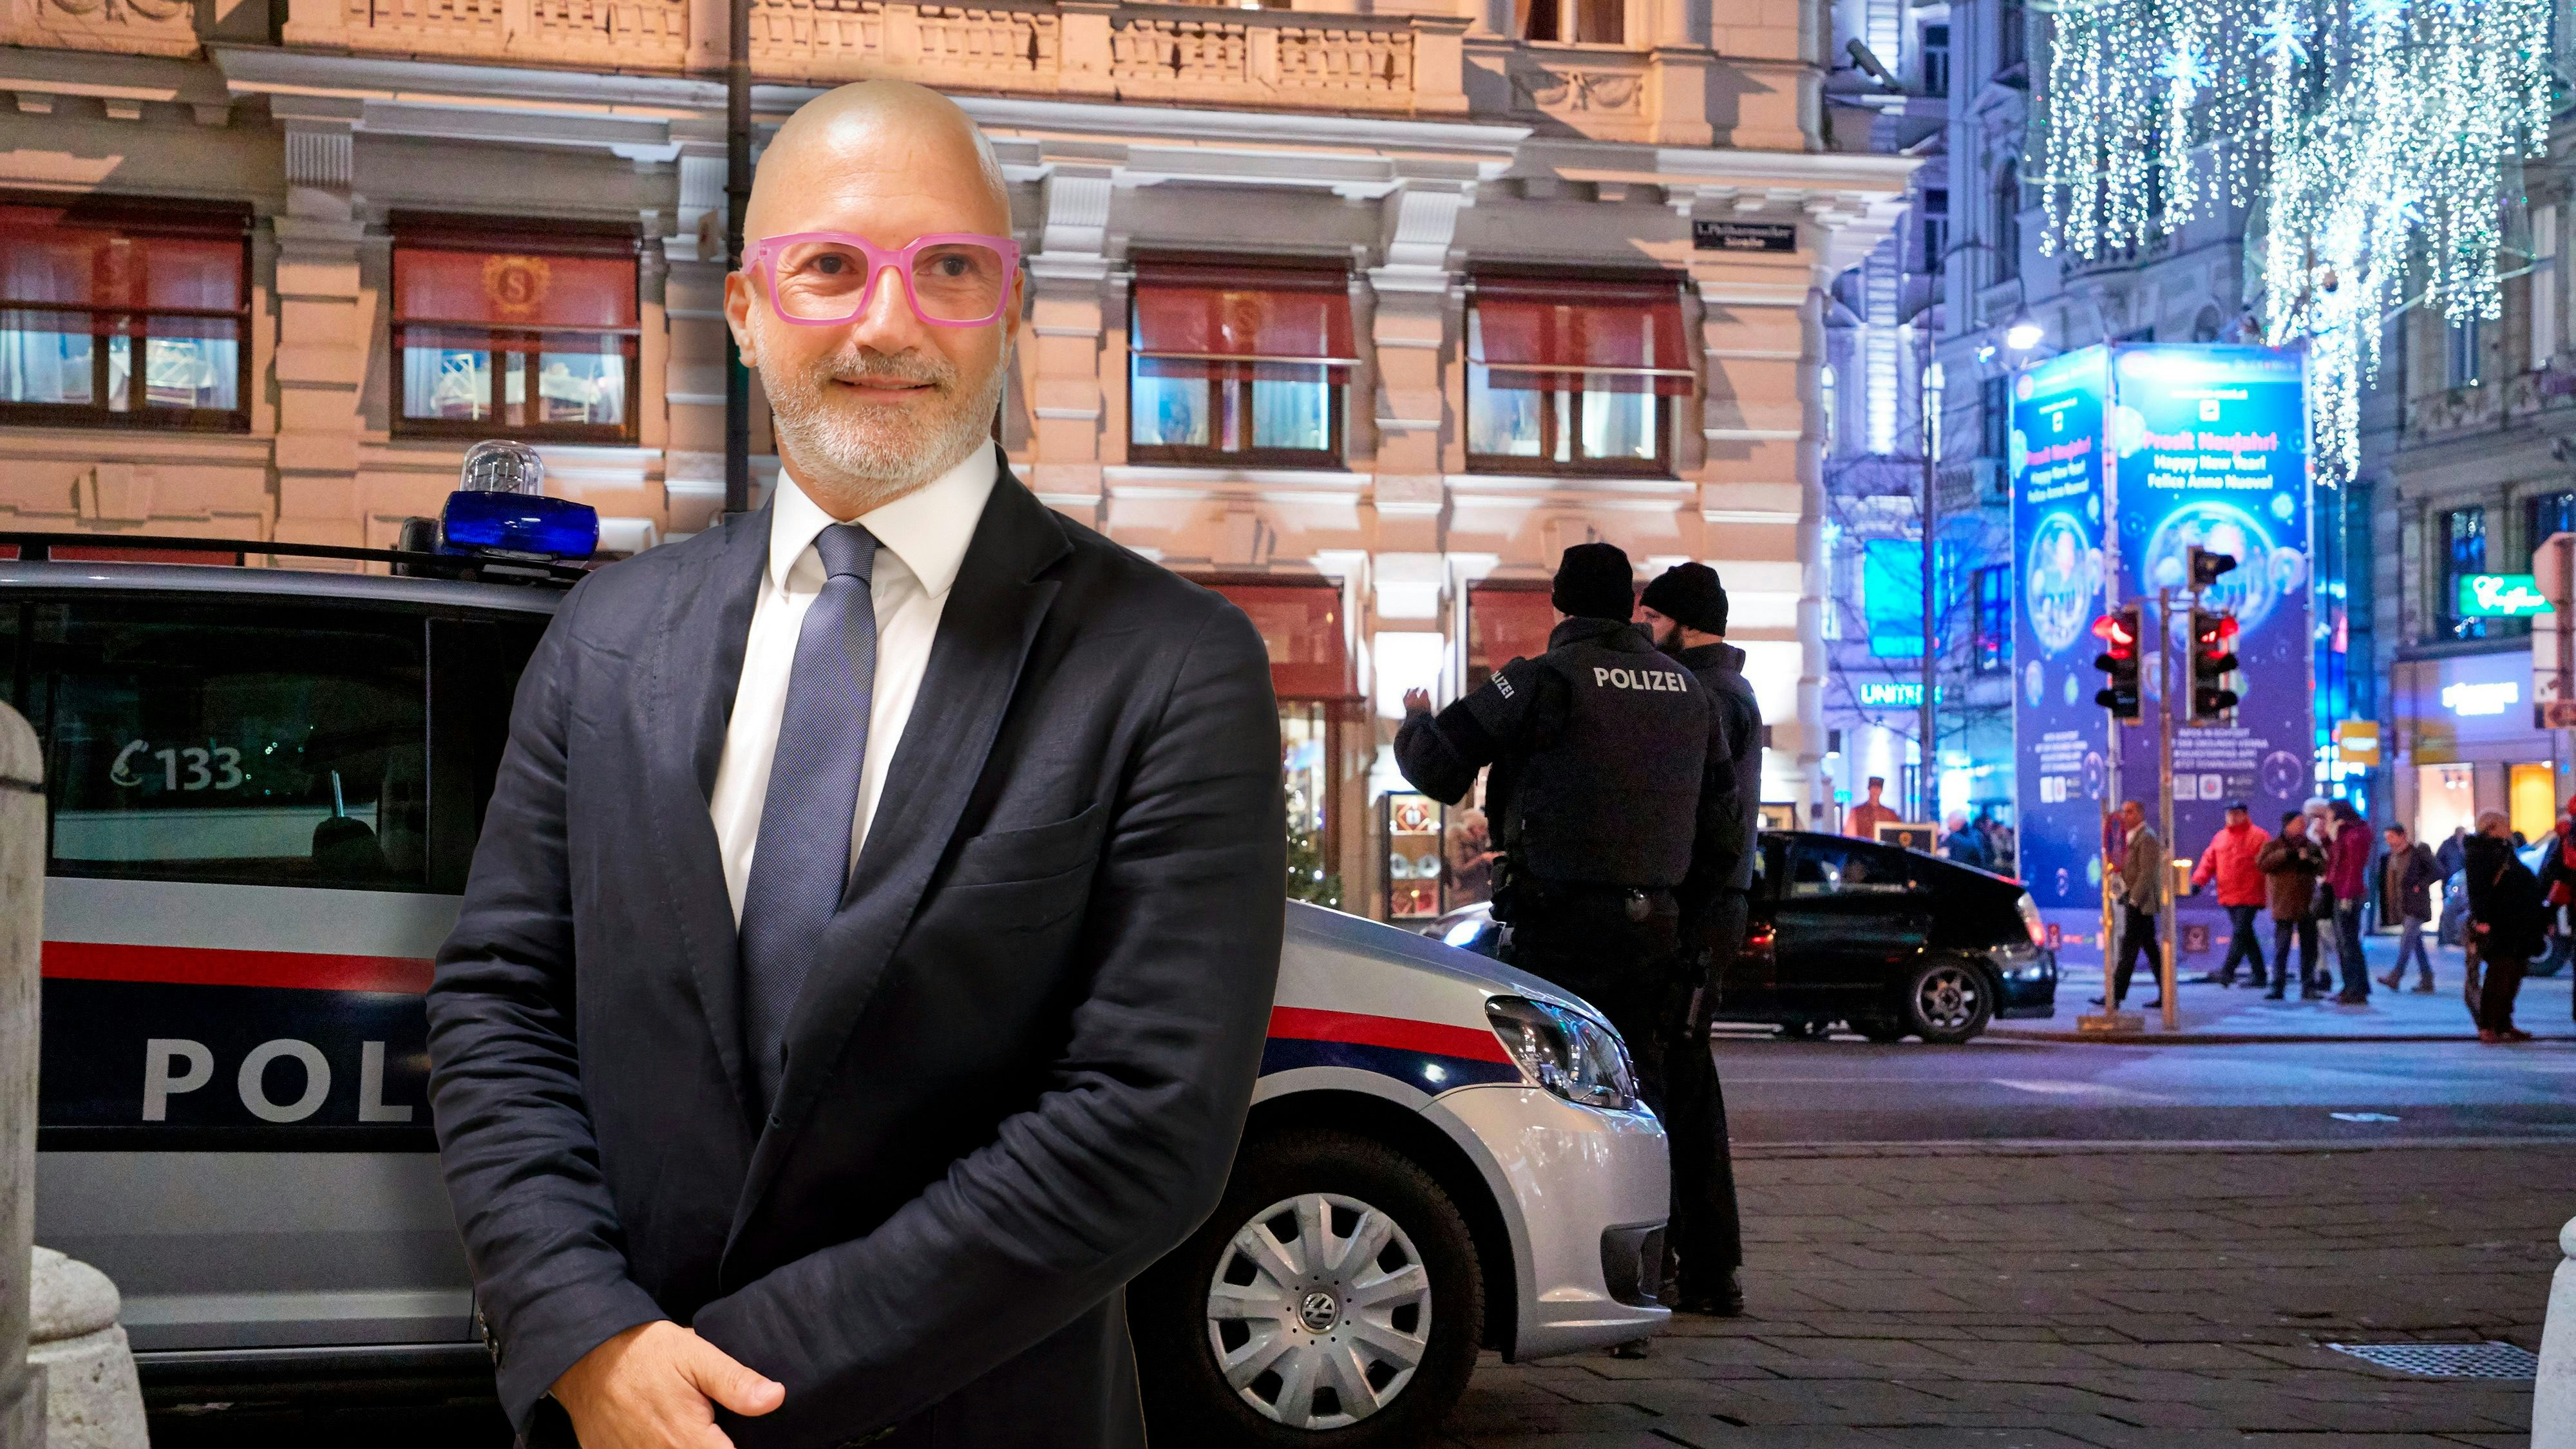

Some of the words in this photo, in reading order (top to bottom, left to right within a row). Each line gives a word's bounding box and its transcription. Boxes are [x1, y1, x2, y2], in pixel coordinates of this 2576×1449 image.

[2154, 454, 2199, 474] Happy
[2199, 455, 2232, 471] New
[1593, 667, 1687, 692] POLIZEI
[155, 746, 243, 791] 133
[142, 1038, 413, 1123] POL
